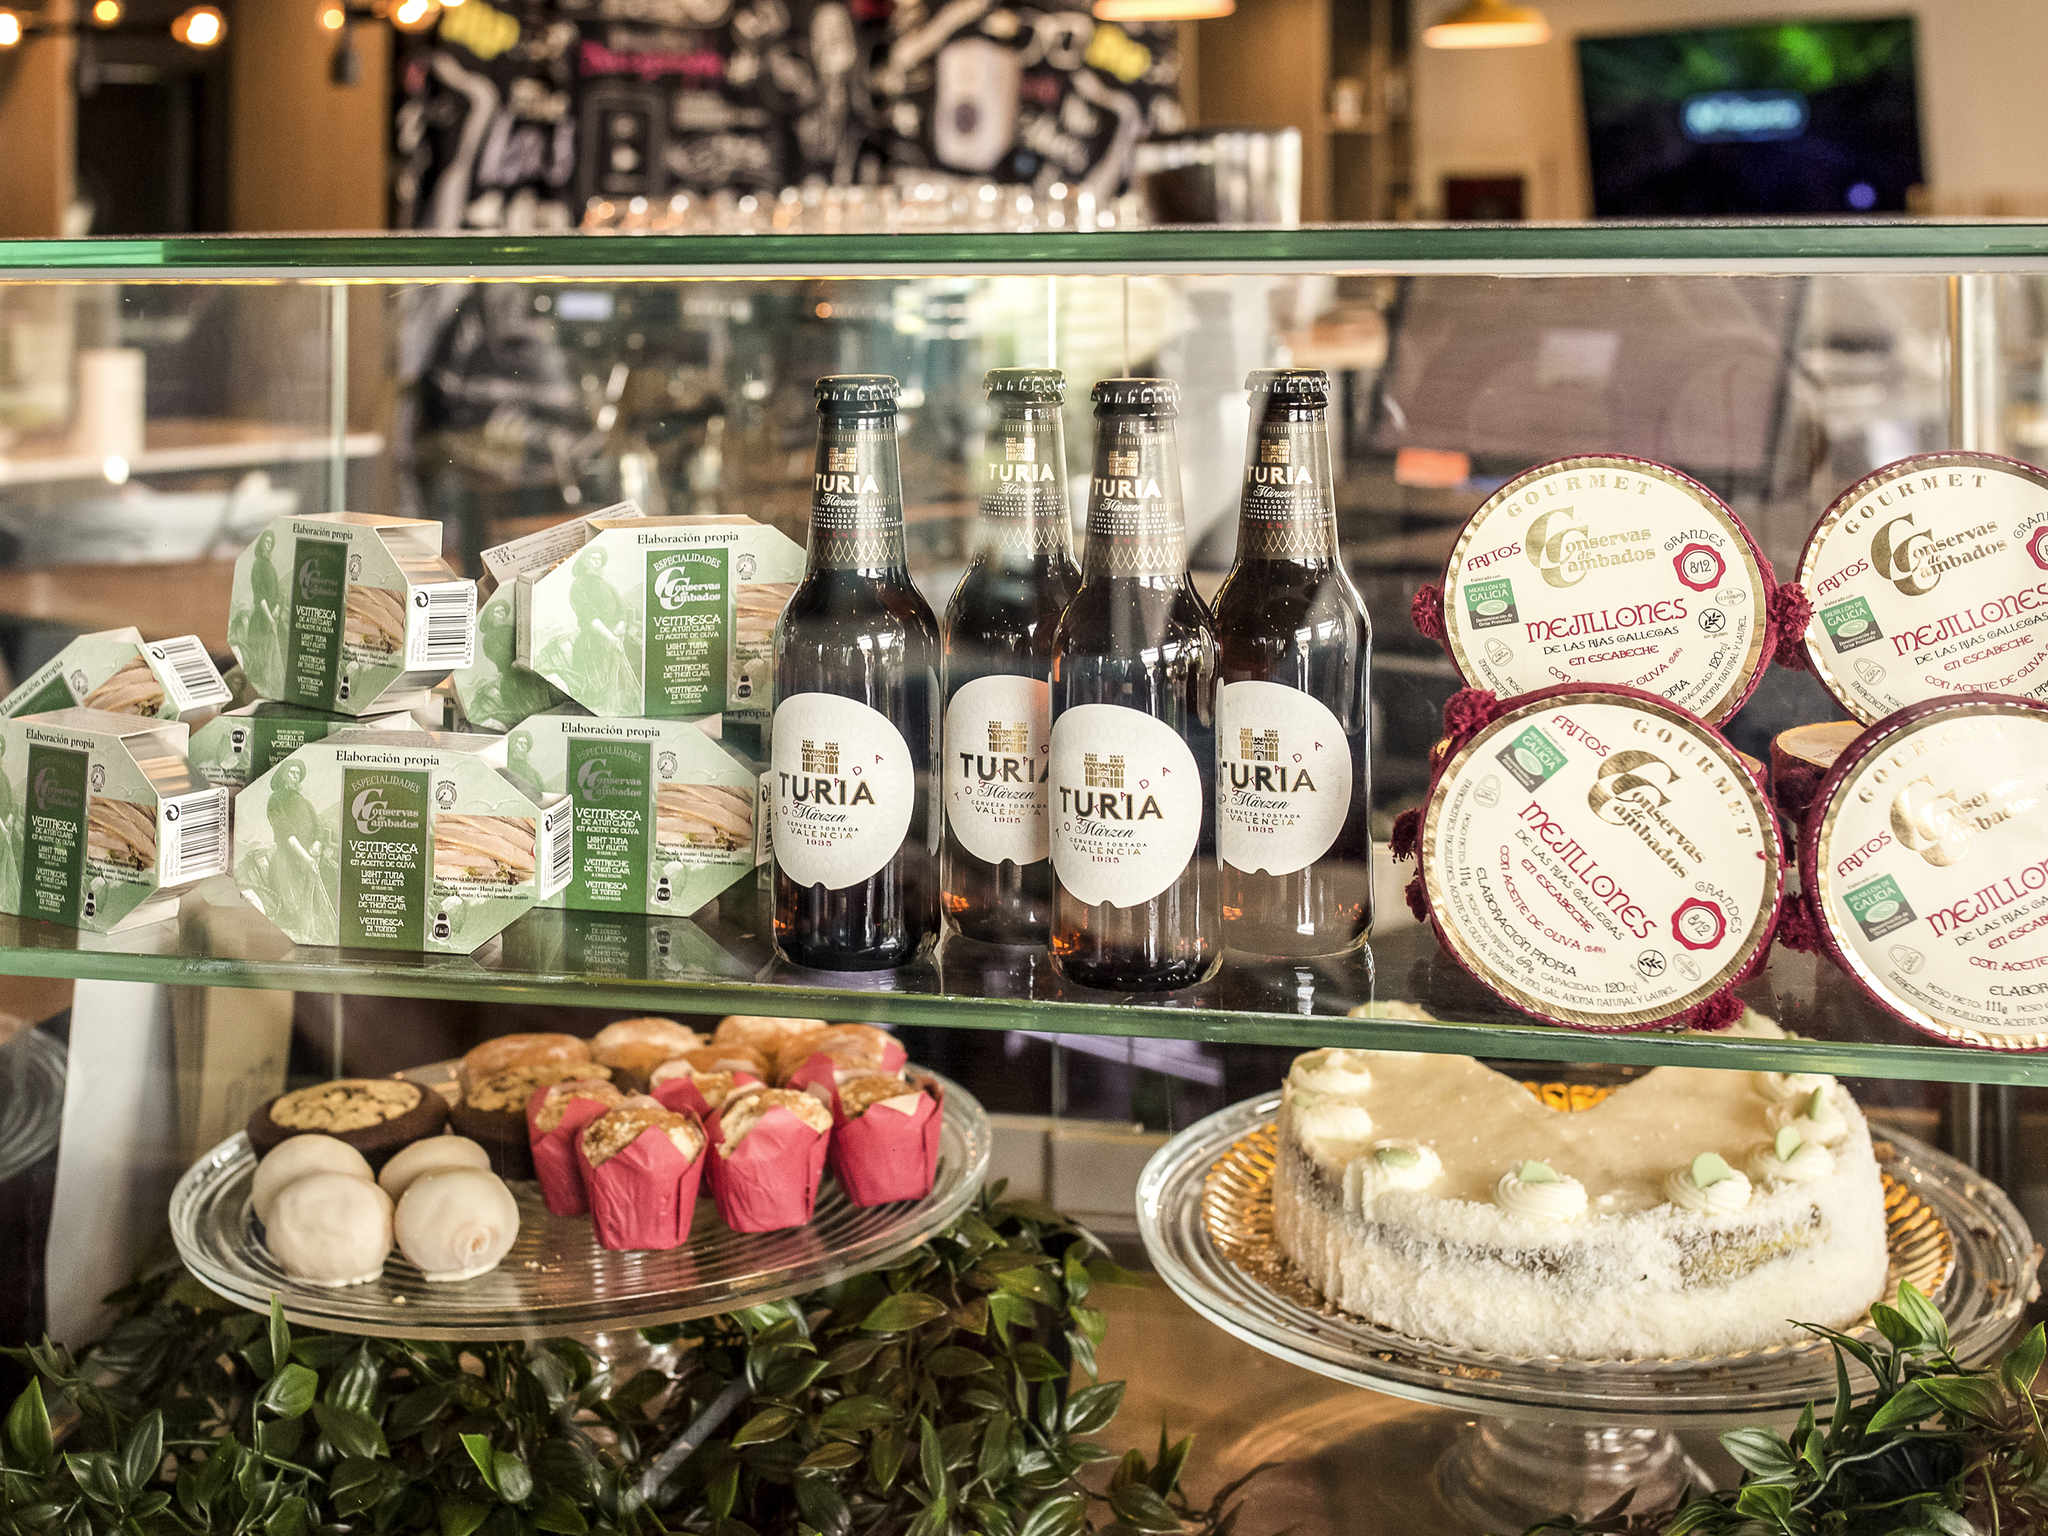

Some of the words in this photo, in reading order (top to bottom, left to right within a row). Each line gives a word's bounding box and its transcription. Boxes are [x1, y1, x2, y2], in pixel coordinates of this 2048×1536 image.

[816, 472, 880, 494] TURIA
[988, 463, 1055, 482] TURIA
[1248, 465, 1313, 484] TURIA
[1094, 478, 1162, 498] TURIA
[1506, 474, 1653, 518] GOURMET
[1844, 474, 1988, 535] GOURMET
[292, 523, 331, 537] Elaboración
[332, 530, 353, 541] propia
[2013, 512, 2048, 539] GRAN
[637, 533, 701, 544] Elaboración
[704, 532, 739, 544] propia
[1663, 529, 1726, 551] GRANDES
[653, 552, 721, 572] ESPECIALIDADES
[1467, 542, 1521, 571] FRITOS
[1689, 559, 1712, 574] 8/12
[1817, 558, 1869, 596] FRITOS
[1469, 589, 1510, 602] GALICIA
[653, 614, 722, 627] VENTRESCA
[1525, 598, 1688, 643] MEJILLONES
[1827, 608, 1867, 626] GALICIA
[1889, 583, 2048, 657] MEJILLONES
[1543, 646, 1561, 655] DE
[1563, 641, 1586, 651] LAS
[1617, 626, 1679, 642] GALLEGAS
[1915, 654, 1933, 666] DE
[1934, 644, 1958, 658] LAS
[1986, 611, 2048, 640] GALLEGAS
[1588, 645, 1659, 664] ESCABECHE
[1963, 635, 2034, 665] ESCABECHE
[1636, 664, 1669, 685] OLIVA
[1925, 675, 1950, 689] CON
[2000, 674, 2017, 687] DE
[2018, 652, 2047, 678] OLIVA
[26, 728, 69, 745] Elaboración
[70, 738, 95, 750] propia
[561, 722, 623, 735] Elaboración
[626, 727, 660, 738] propia
[1552, 715, 1611, 757] FRITOS
[336, 750, 400, 764] Elaboración
[404, 755, 440, 767] propia
[1522, 735, 1557, 771] GALICIA
[352, 775, 421, 794] ESPECIALIDADES
[779, 771, 876, 806] TURIA
[1632, 718, 1754, 838] GOURMET
[977, 782, 1037, 800] Märzen
[1231, 789, 1289, 809] Märzen
[792, 803, 848, 822] Märzen
[1060, 786, 1164, 820] TURIA
[575, 808, 642, 821] VENTRESCA
[1229, 815, 1294, 826] VALENCIA
[790, 827, 854, 840] VALENCIA
[1075, 818, 1136, 838] Märzen
[349, 840, 419, 855] VENTRESCA
[1073, 844, 1141, 856] VALENCIA
[1837, 830, 1892, 878] FRITOS
[1517, 800, 1658, 939] MEJILLONES
[1514, 828, 1533, 847] DE
[1531, 845, 1552, 866] LAS
[1573, 888, 1625, 941] GALLEGAS
[1502, 873, 1530, 916] ACEITE
[1527, 914, 1544, 931] DE
[1544, 928, 1582, 950] OLIVA
[1536, 874, 1595, 934] ESCABECHE
[1694, 881, 1743, 934] GRANDES
[1476, 866, 1532, 952] ELABORACIÓN
[1529, 947, 1578, 978] PROPIA
[1688, 914, 1712, 938] 8/12
[1954, 931, 1976, 946] DE
[1975, 920, 2000, 936] LAS
[1969, 956, 1998, 971] CON
